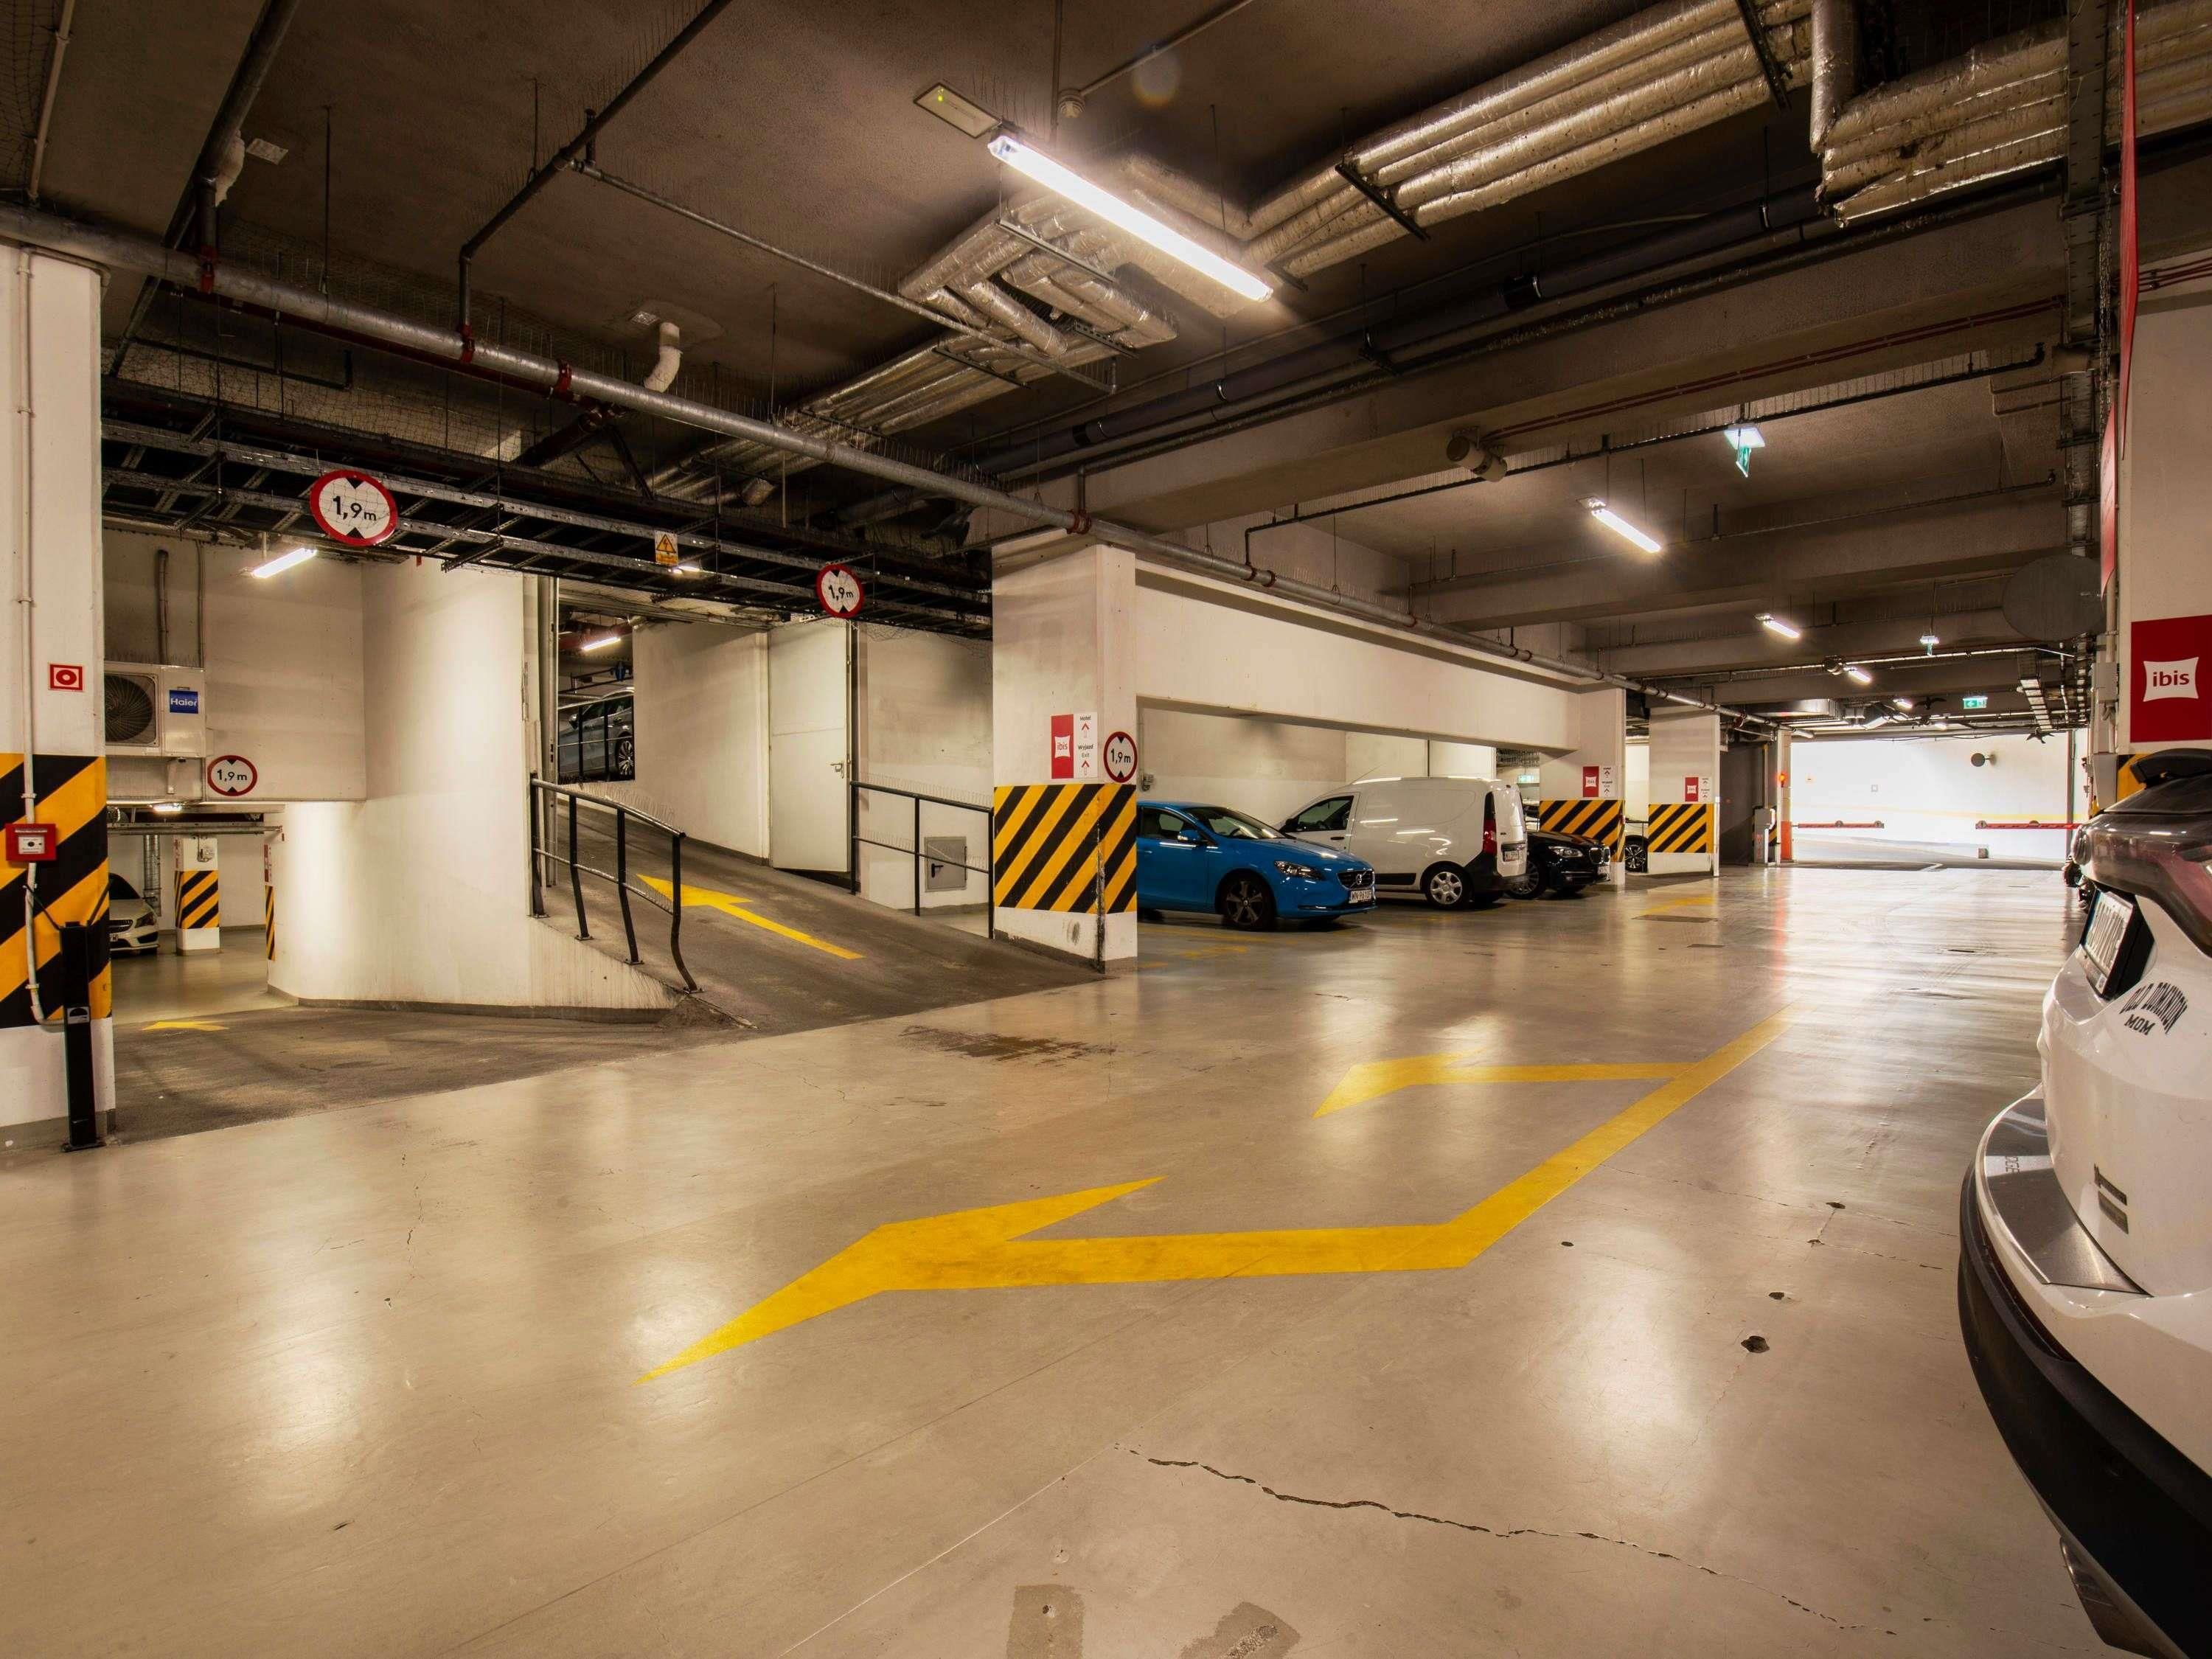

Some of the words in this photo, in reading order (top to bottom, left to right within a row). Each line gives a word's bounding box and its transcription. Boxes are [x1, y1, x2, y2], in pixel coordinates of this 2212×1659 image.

[2153, 670, 2189, 686] ibis
[170, 698, 197, 706] Haier
[1057, 742, 1068, 751] ibis
[2124, 1014, 2155, 1035] MOM
